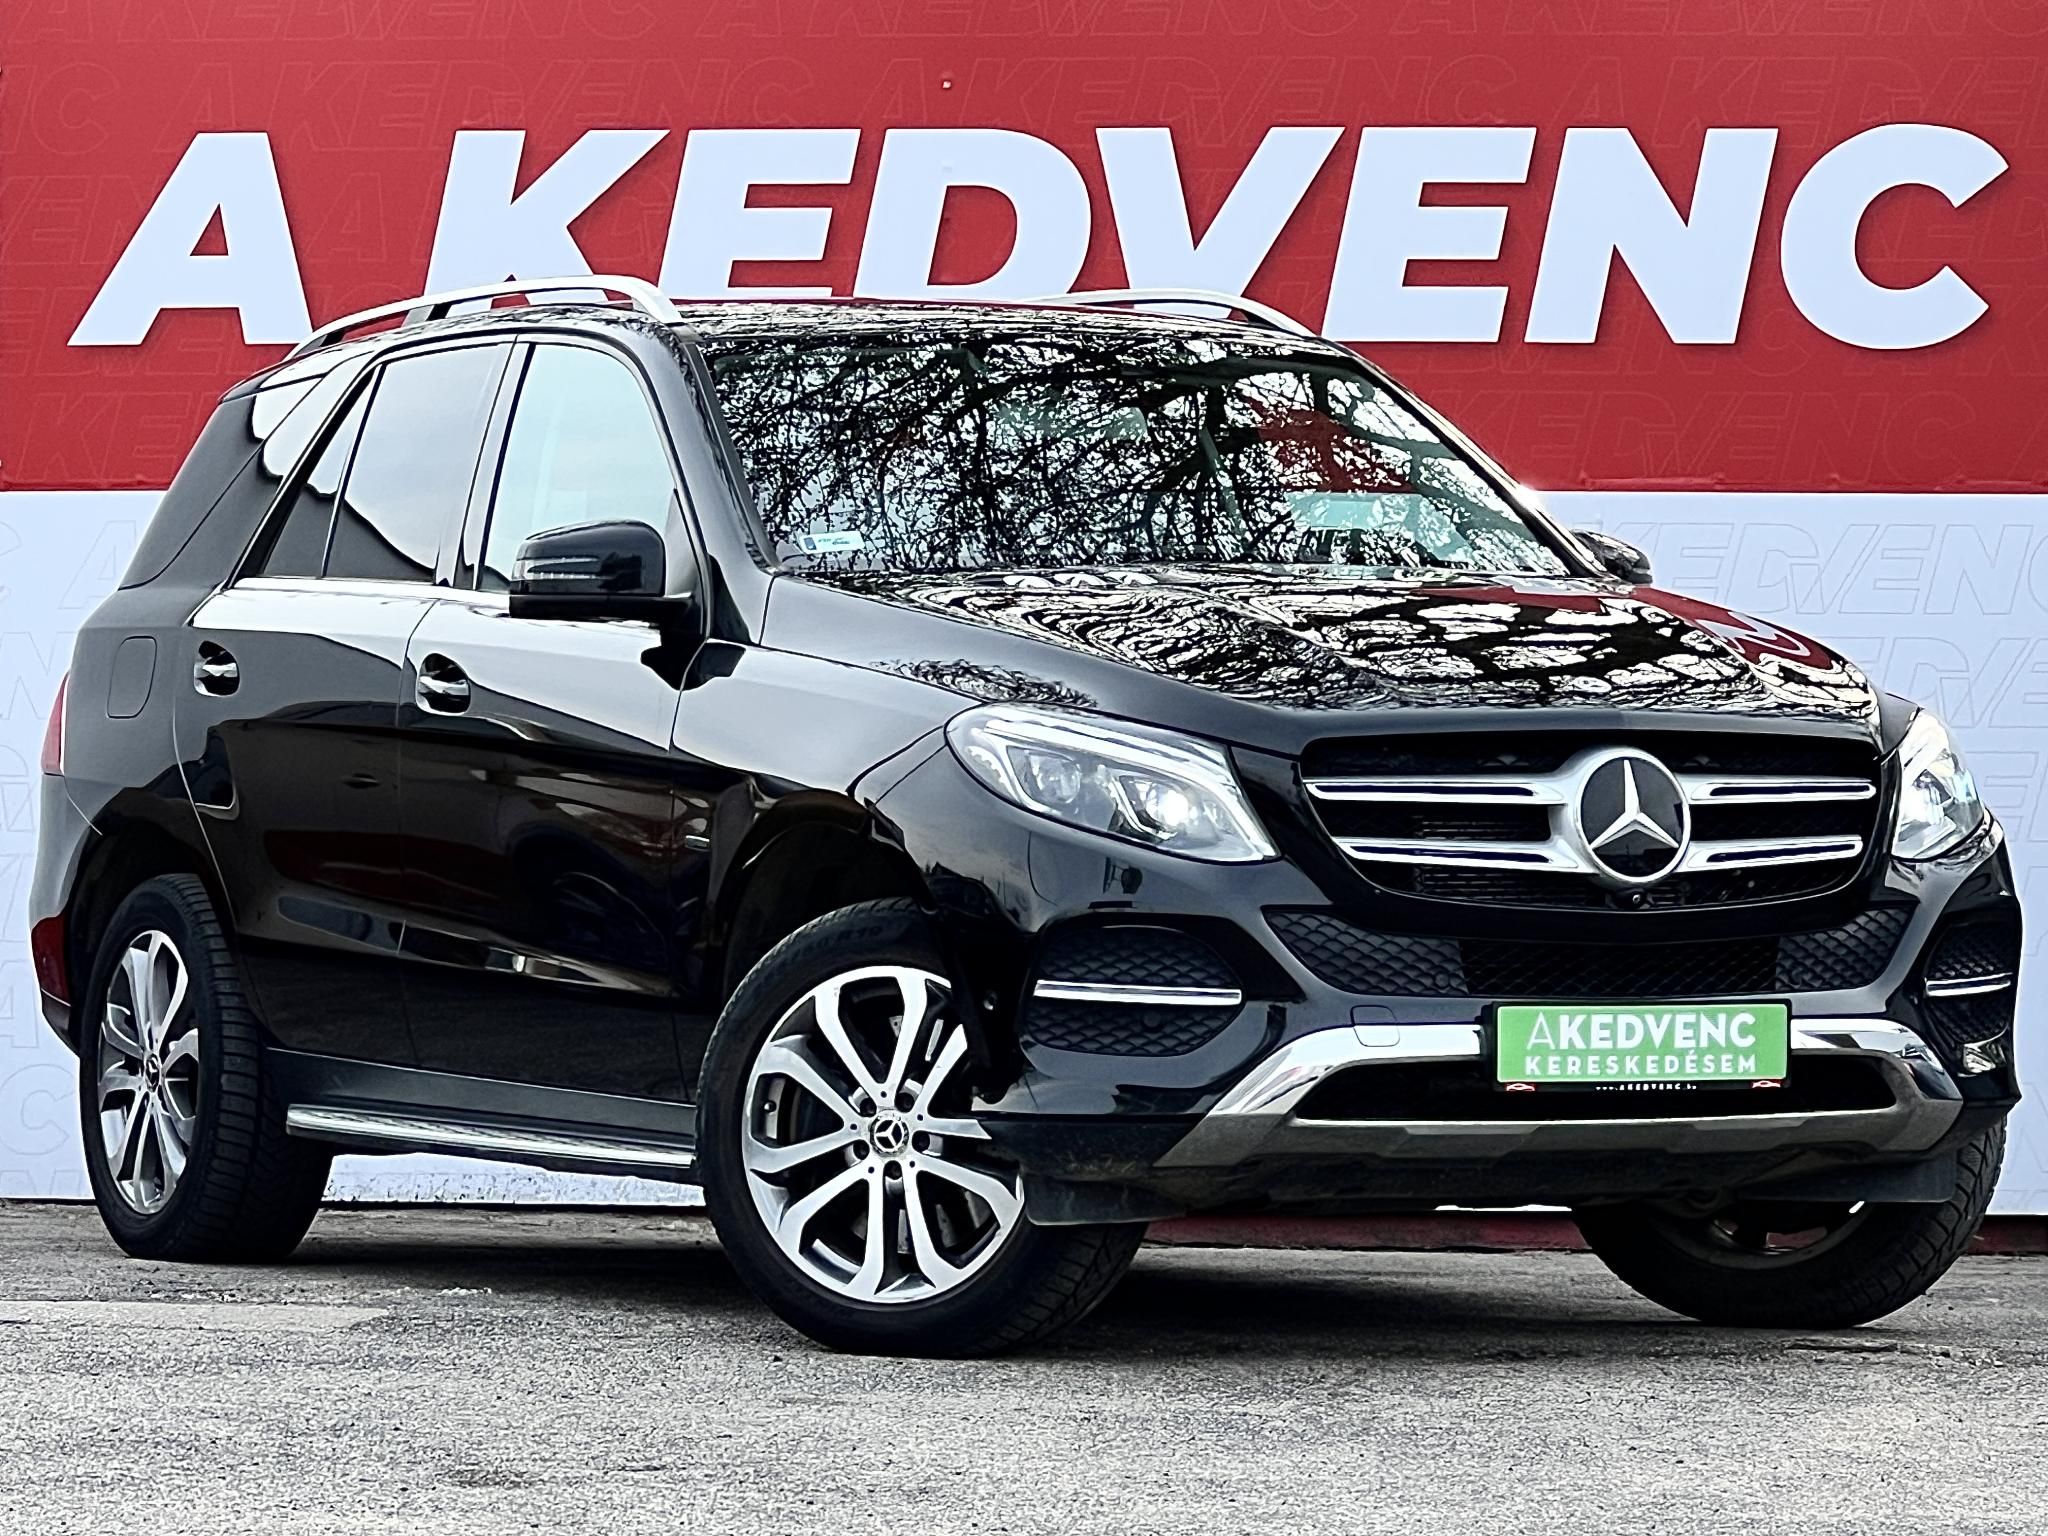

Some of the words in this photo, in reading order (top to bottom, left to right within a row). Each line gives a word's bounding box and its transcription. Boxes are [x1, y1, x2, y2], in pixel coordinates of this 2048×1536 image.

[68, 131, 314, 346] A
[422, 123, 2010, 350] KEDVENC
[1526, 1011, 1757, 1050] AKEDVENC
[1524, 1049, 1757, 1076] KERESKEDÉSEM
